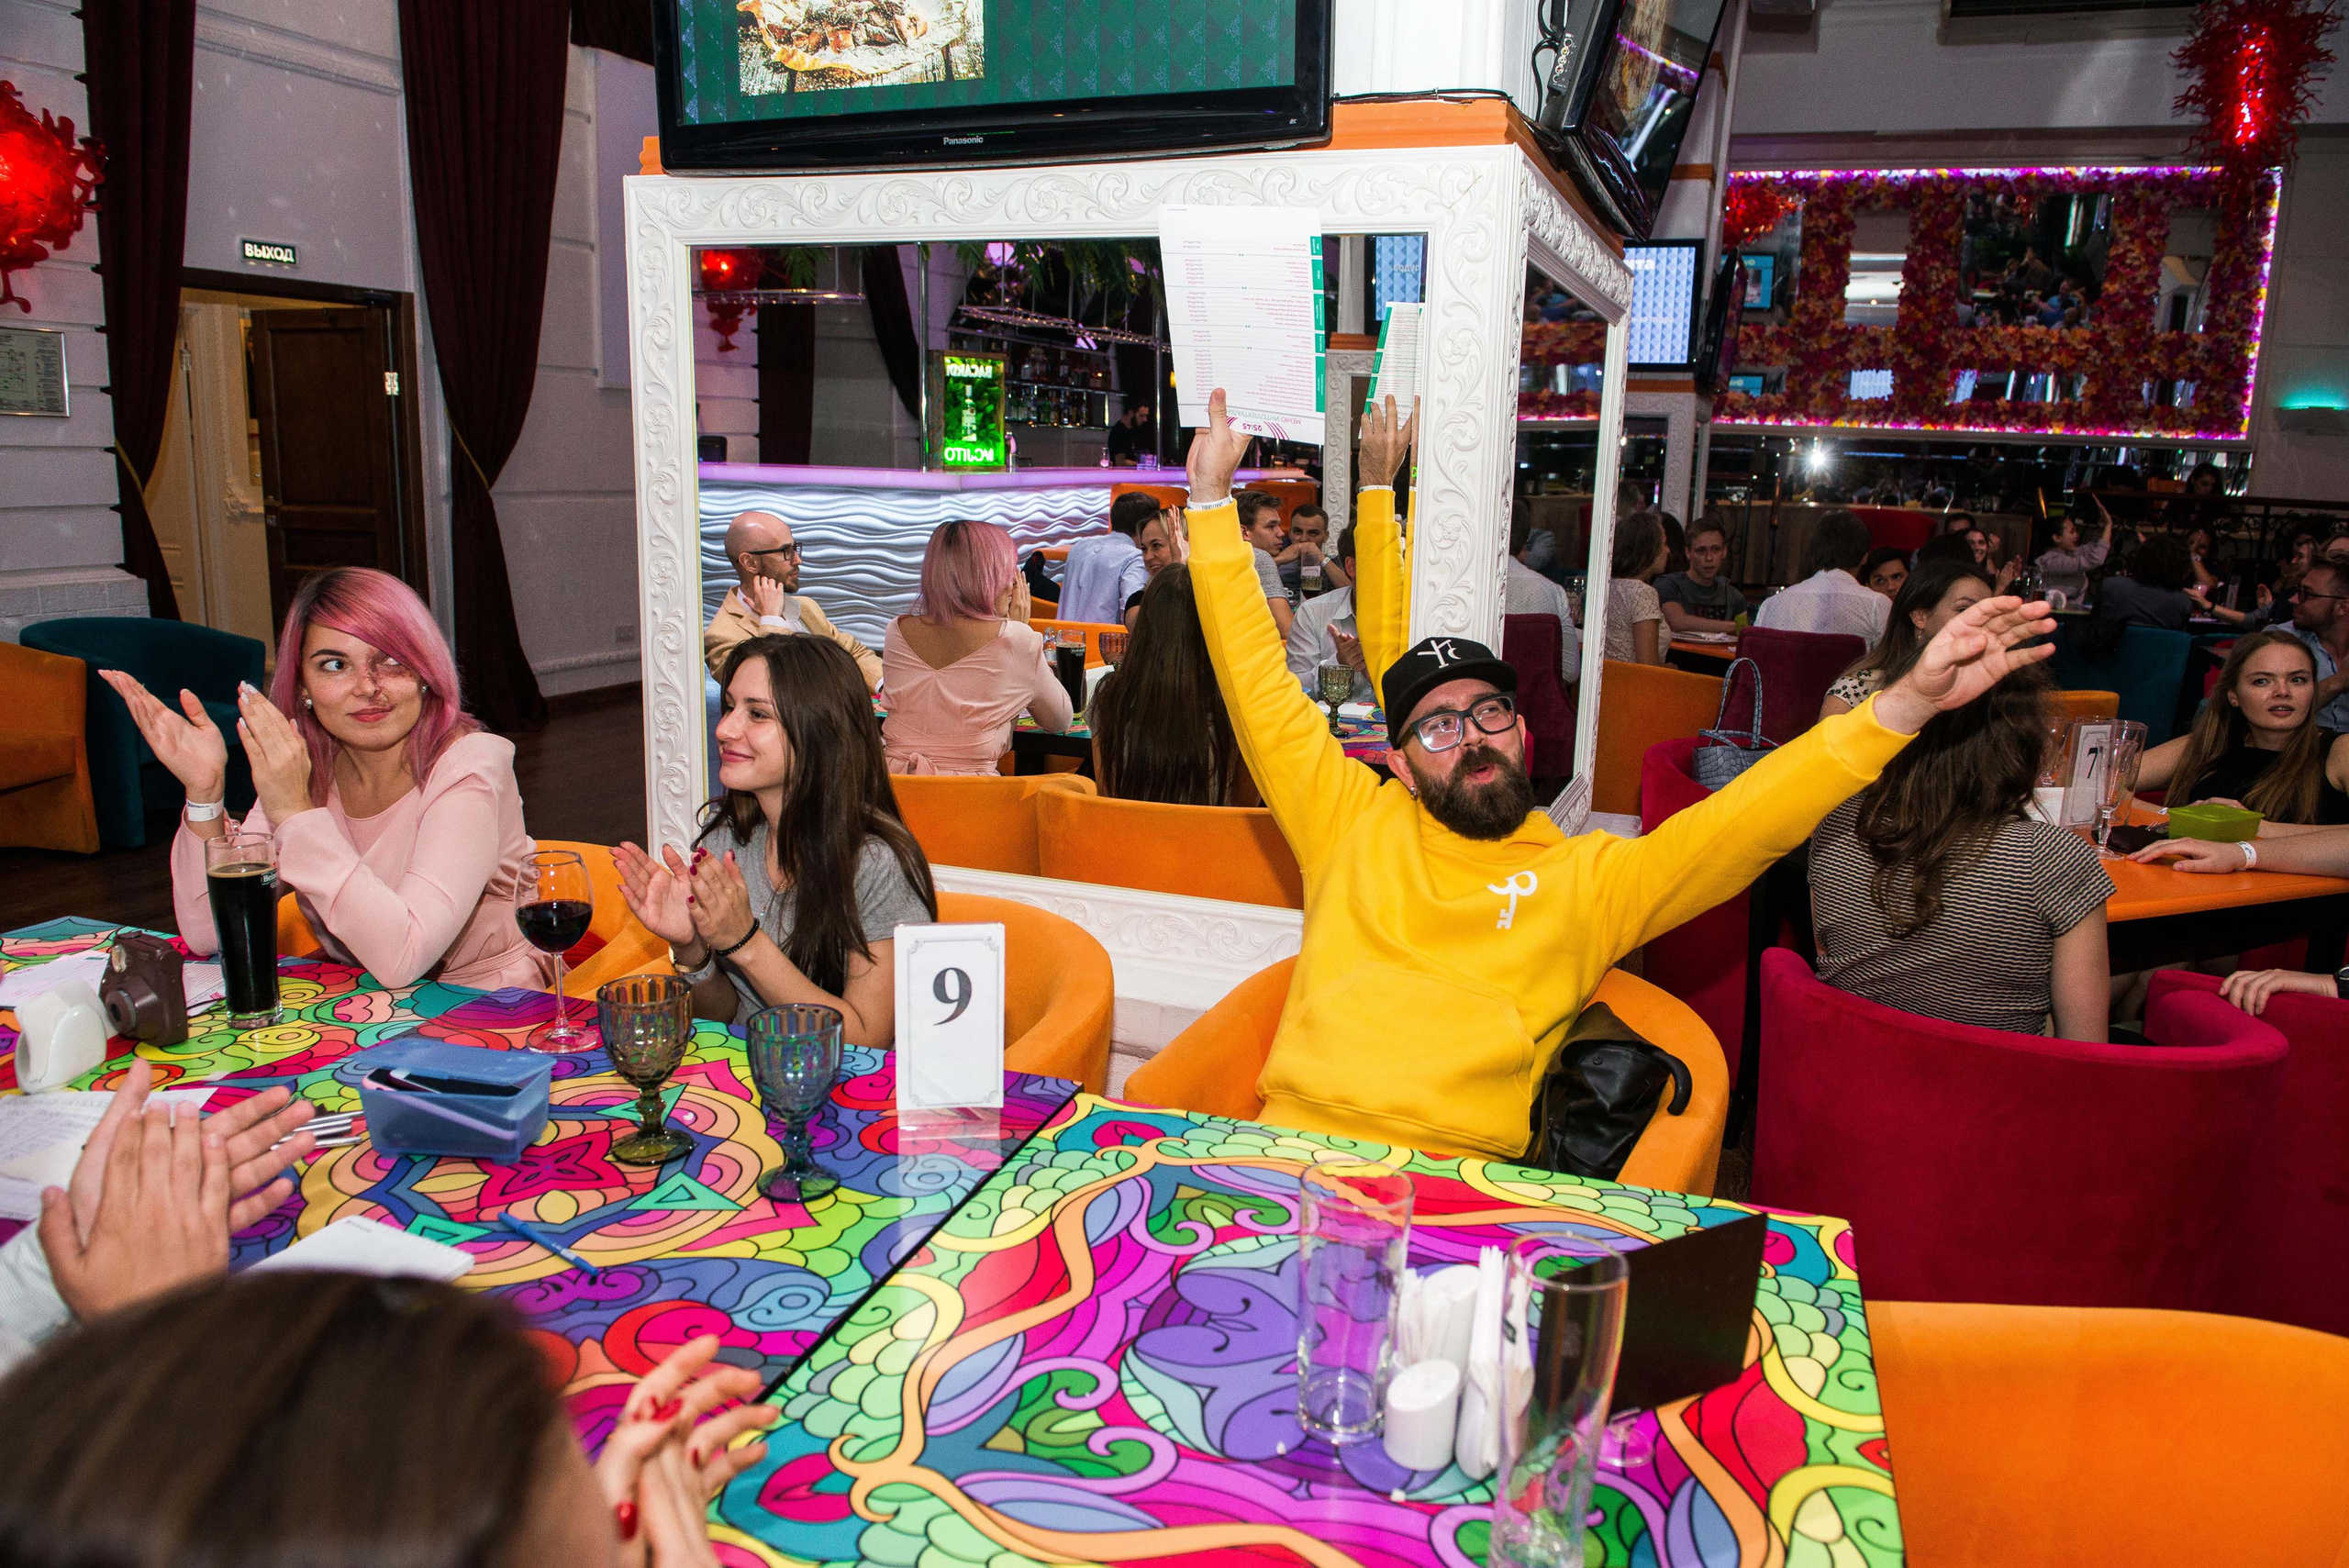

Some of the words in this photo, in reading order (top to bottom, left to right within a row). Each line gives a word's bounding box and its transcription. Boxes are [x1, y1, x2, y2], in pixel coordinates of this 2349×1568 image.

[943, 135, 984, 145] Panasonic
[244, 242, 295, 262] ВЫХОД
[1241, 422, 1264, 432] 25:45
[1280, 416, 1302, 425] МЕНЮ
[2087, 746, 2103, 779] 7
[932, 967, 973, 1026] 9
